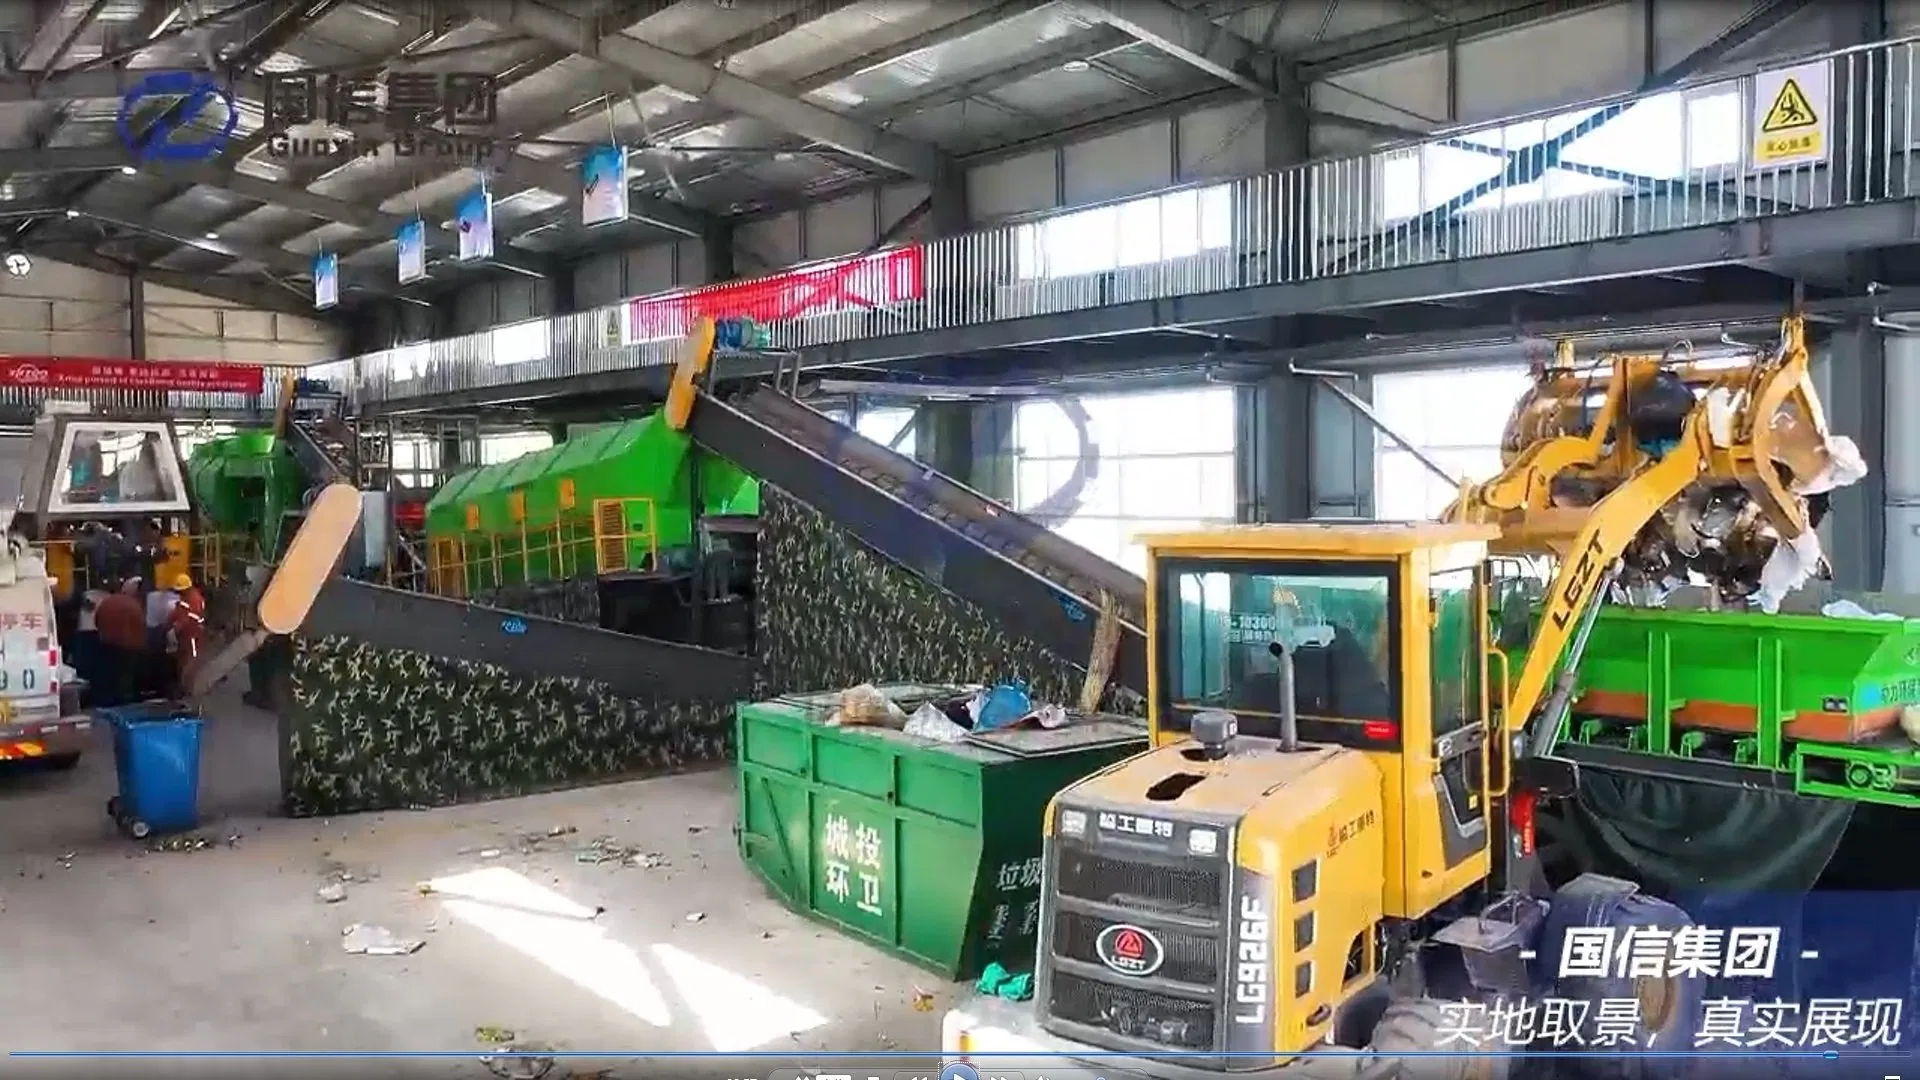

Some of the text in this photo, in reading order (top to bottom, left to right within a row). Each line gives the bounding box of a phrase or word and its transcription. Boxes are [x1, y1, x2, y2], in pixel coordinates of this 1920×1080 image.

[1552, 528, 1603, 632] LGZT
[825, 859, 883, 917] 环卫
[1235, 895, 1267, 1024] LG926F
